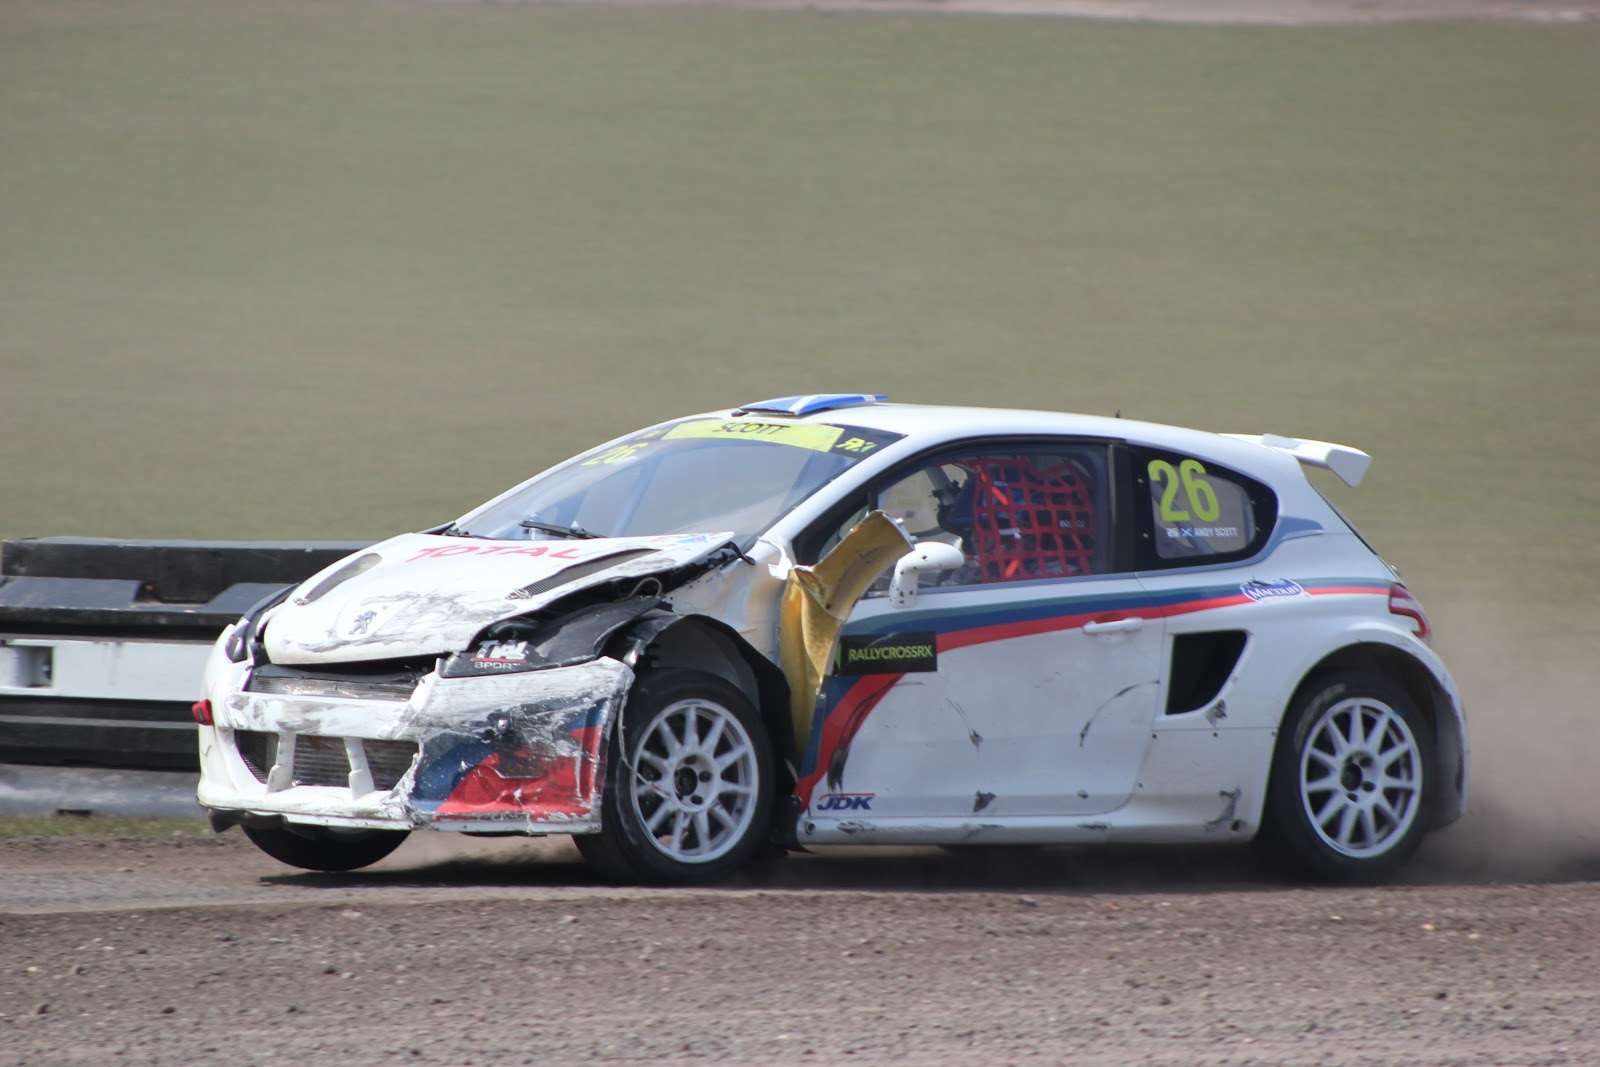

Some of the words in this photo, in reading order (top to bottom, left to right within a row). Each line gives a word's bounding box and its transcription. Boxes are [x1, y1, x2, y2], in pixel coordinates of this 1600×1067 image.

[712, 422, 790, 435] SCOTT
[1147, 459, 1221, 523] 26
[1215, 527, 1238, 537] SCOTT
[405, 544, 579, 562] TOTAL
[848, 645, 933, 661] RALLYCROSSRX
[817, 796, 873, 810] JDK
